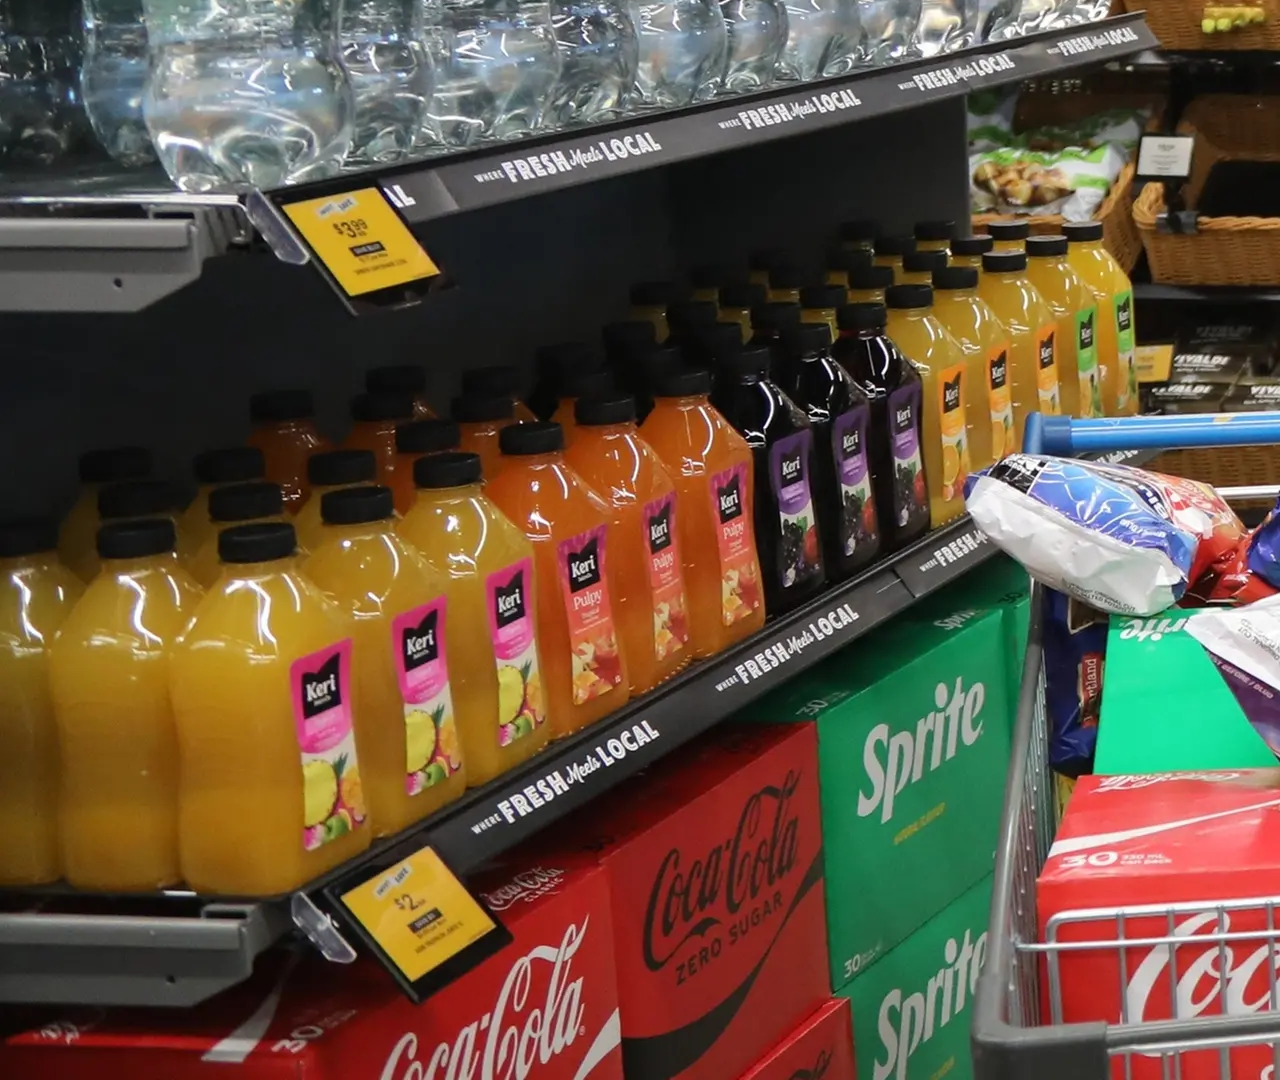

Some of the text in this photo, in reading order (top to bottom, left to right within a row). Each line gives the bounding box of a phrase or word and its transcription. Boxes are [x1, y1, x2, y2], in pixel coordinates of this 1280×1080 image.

[1057, 26, 1139, 56] FRESH LOCAL
[914, 53, 1016, 92] FRESH LOCAL
[738, 103, 794, 131] FRESH
[814, 88, 862, 115] LOCAL
[474, 168, 504, 184] WHERE
[501, 150, 571, 183] FRESH
[599, 131, 663, 163] LOCAL
[895, 404, 911, 423] Keri
[843, 430, 859, 449] Keri
[782, 456, 801, 477] Keri
[720, 490, 739, 512] Keri
[651, 519, 668, 541] Keri
[723, 521, 745, 541] Pulpy
[652, 552, 675, 571] Pulpy
[933, 532, 977, 568] FRESH
[571, 555, 595, 579] Keri
[497, 589, 522, 615] Keri
[572, 589, 602, 611] Pulpy
[406, 629, 435, 656] Keri
[1119, 617, 1190, 643] rite
[715, 674, 739, 693] WHERE
[735, 641, 790, 686] FRESH
[811, 603, 860, 643] LOCAL
[305, 672, 337, 702] Keri
[857, 676, 985, 824] Sprite
[472, 814, 502, 836] WHERE
[498, 770, 571, 825] FRESH
[596, 719, 661, 768] LOCAL
[1058, 849, 1120, 869] 30
[675, 890, 785, 987] ZERO SUGAR
[843, 952, 862, 978] 30
